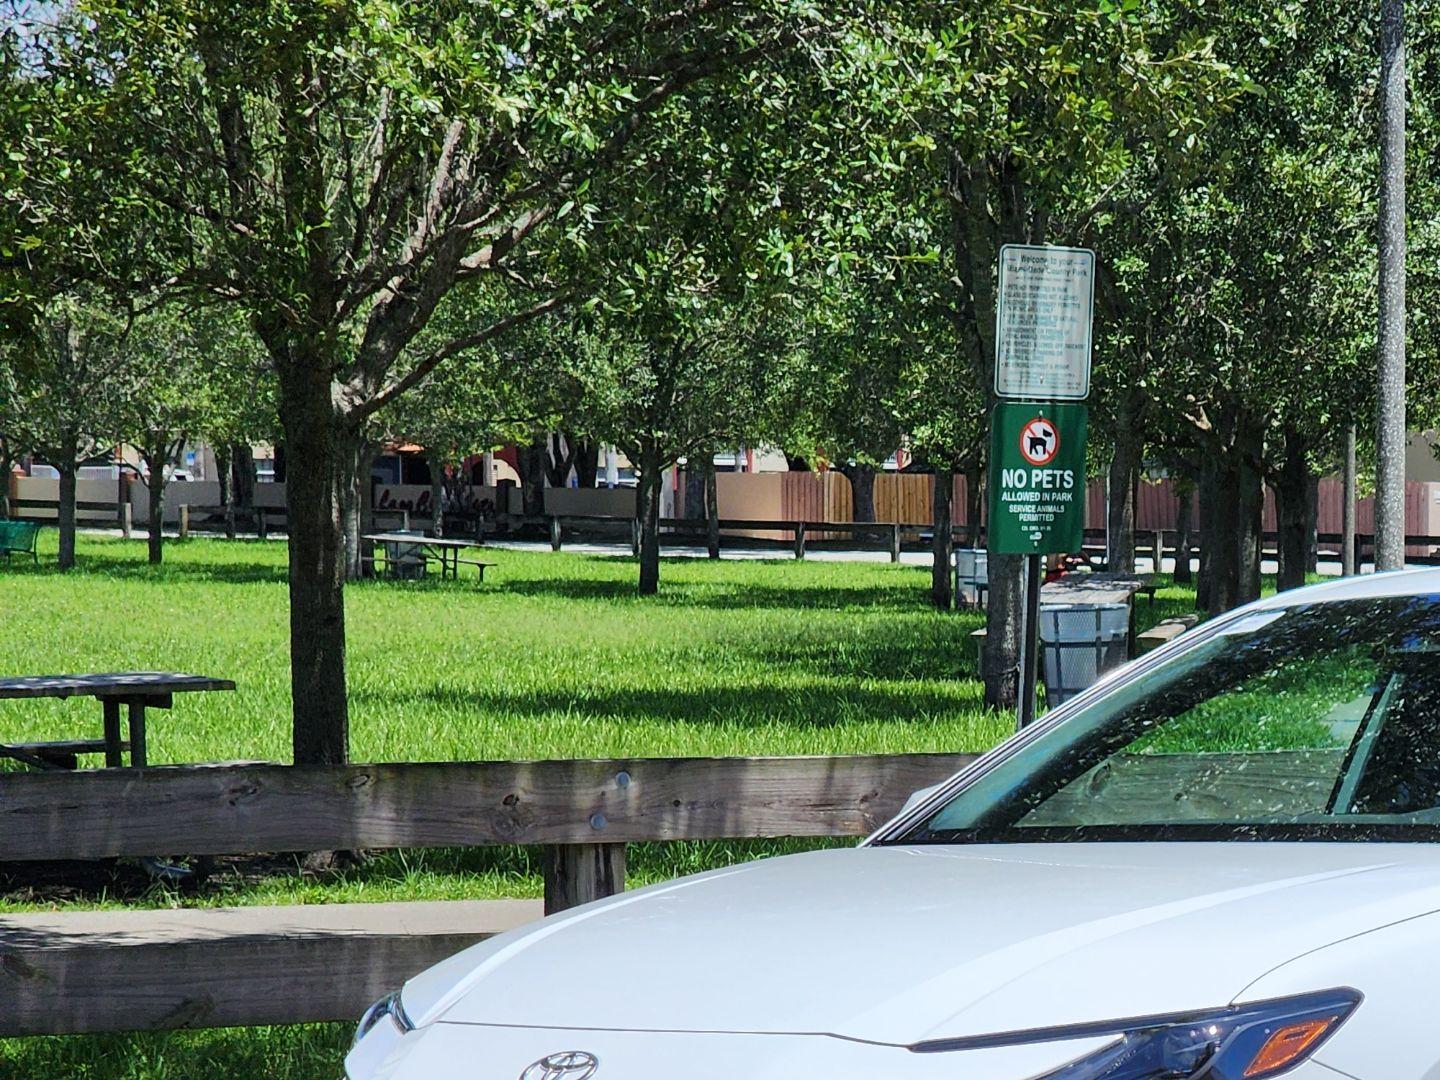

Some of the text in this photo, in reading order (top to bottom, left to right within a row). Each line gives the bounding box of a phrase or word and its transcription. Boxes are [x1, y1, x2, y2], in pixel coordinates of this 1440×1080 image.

[1002, 468, 1074, 489] NO PETS
[1002, 490, 1073, 502] ALLOWED IN PARK
[1009, 504, 1065, 513] SERVICE ANIMALS
[1019, 514, 1054, 522] PERMITTED
